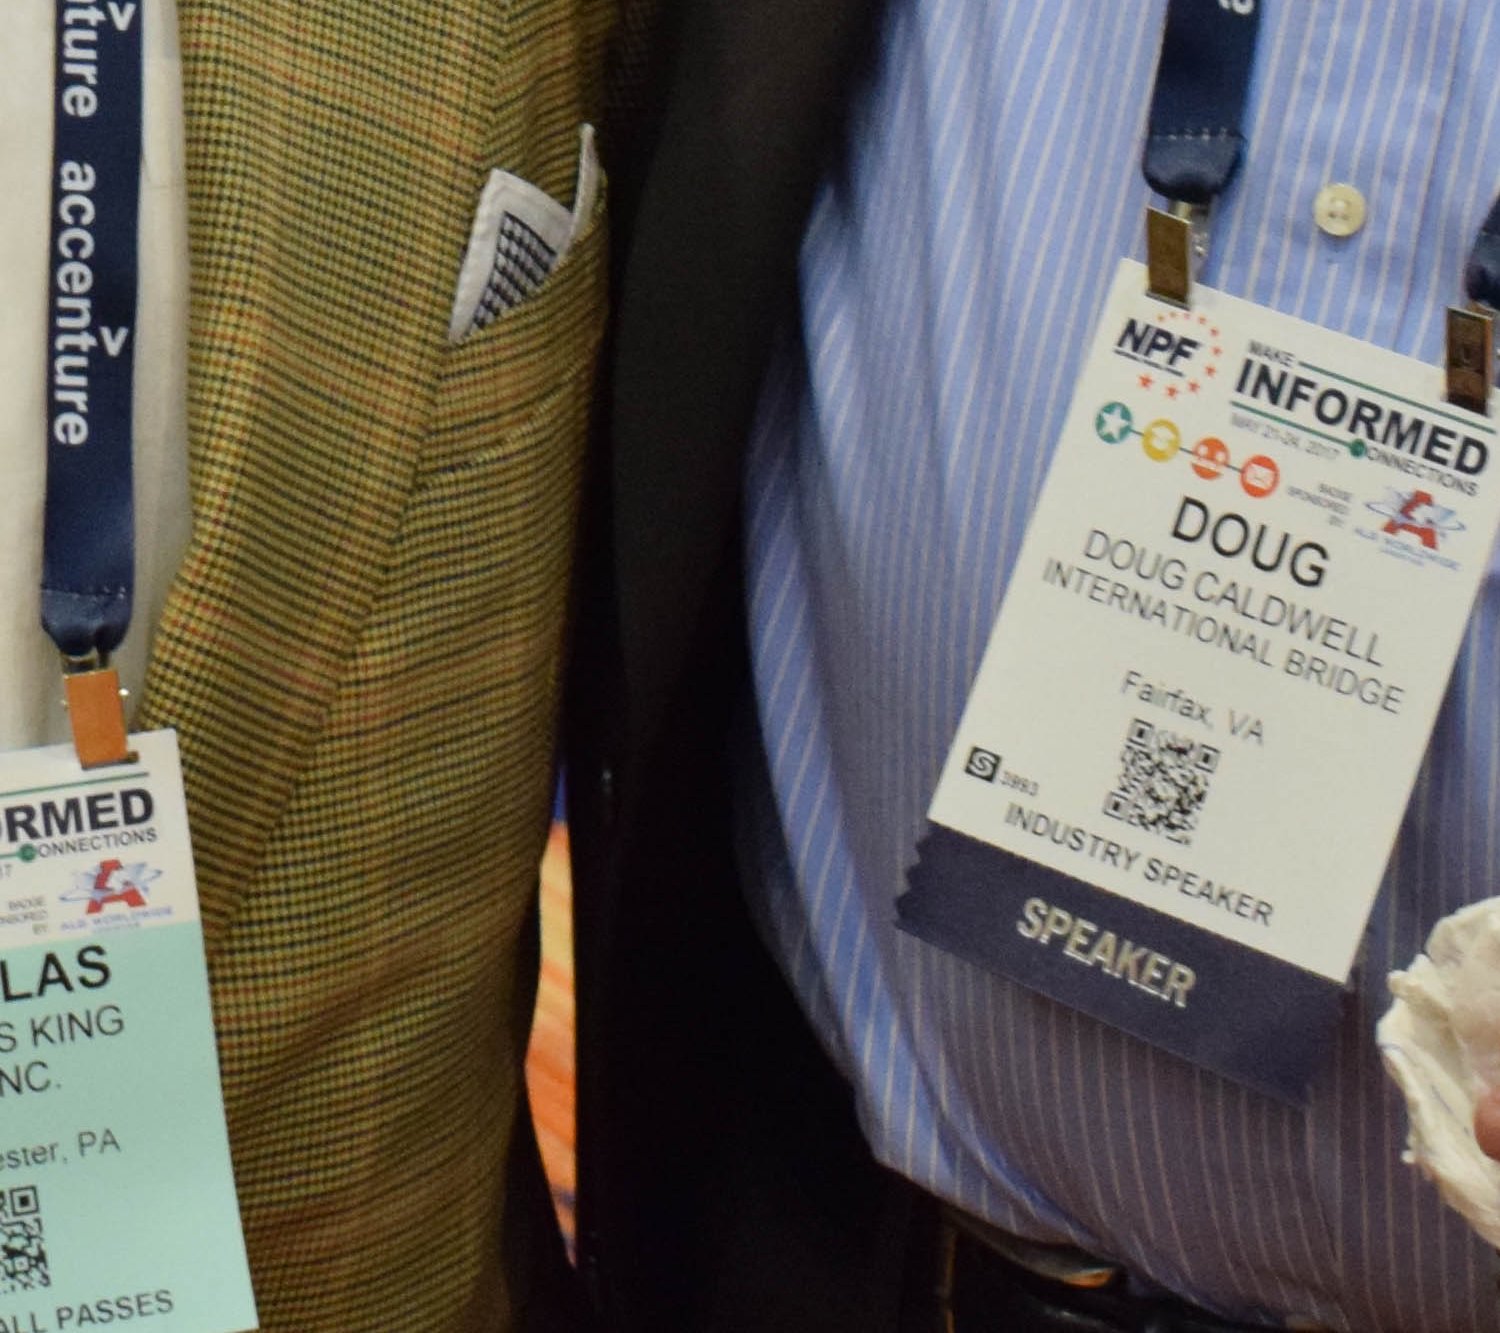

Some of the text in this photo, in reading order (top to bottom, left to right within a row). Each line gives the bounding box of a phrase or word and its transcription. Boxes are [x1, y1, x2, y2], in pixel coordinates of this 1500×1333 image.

[53, 161, 96, 447] accenture
[1117, 318, 1201, 365] NPF
[1249, 339, 1296, 367] MAKE
[1236, 358, 1489, 476] INFORMED
[1172, 496, 1330, 588] DOUG
[1043, 557, 1405, 715] INTERNATIONAL BRIDGE
[1084, 529, 1383, 668] DOUG CALDWELL
[1228, 708, 1266, 746] VA
[1004, 802, 1275, 927] INDUSTRY SPEAKER
[1015, 896, 1198, 1009] SPEAKER
[29, 1004, 125, 1048] KING
[77, 1128, 121, 1158] PA
[56, 1290, 175, 1331] PASSES
